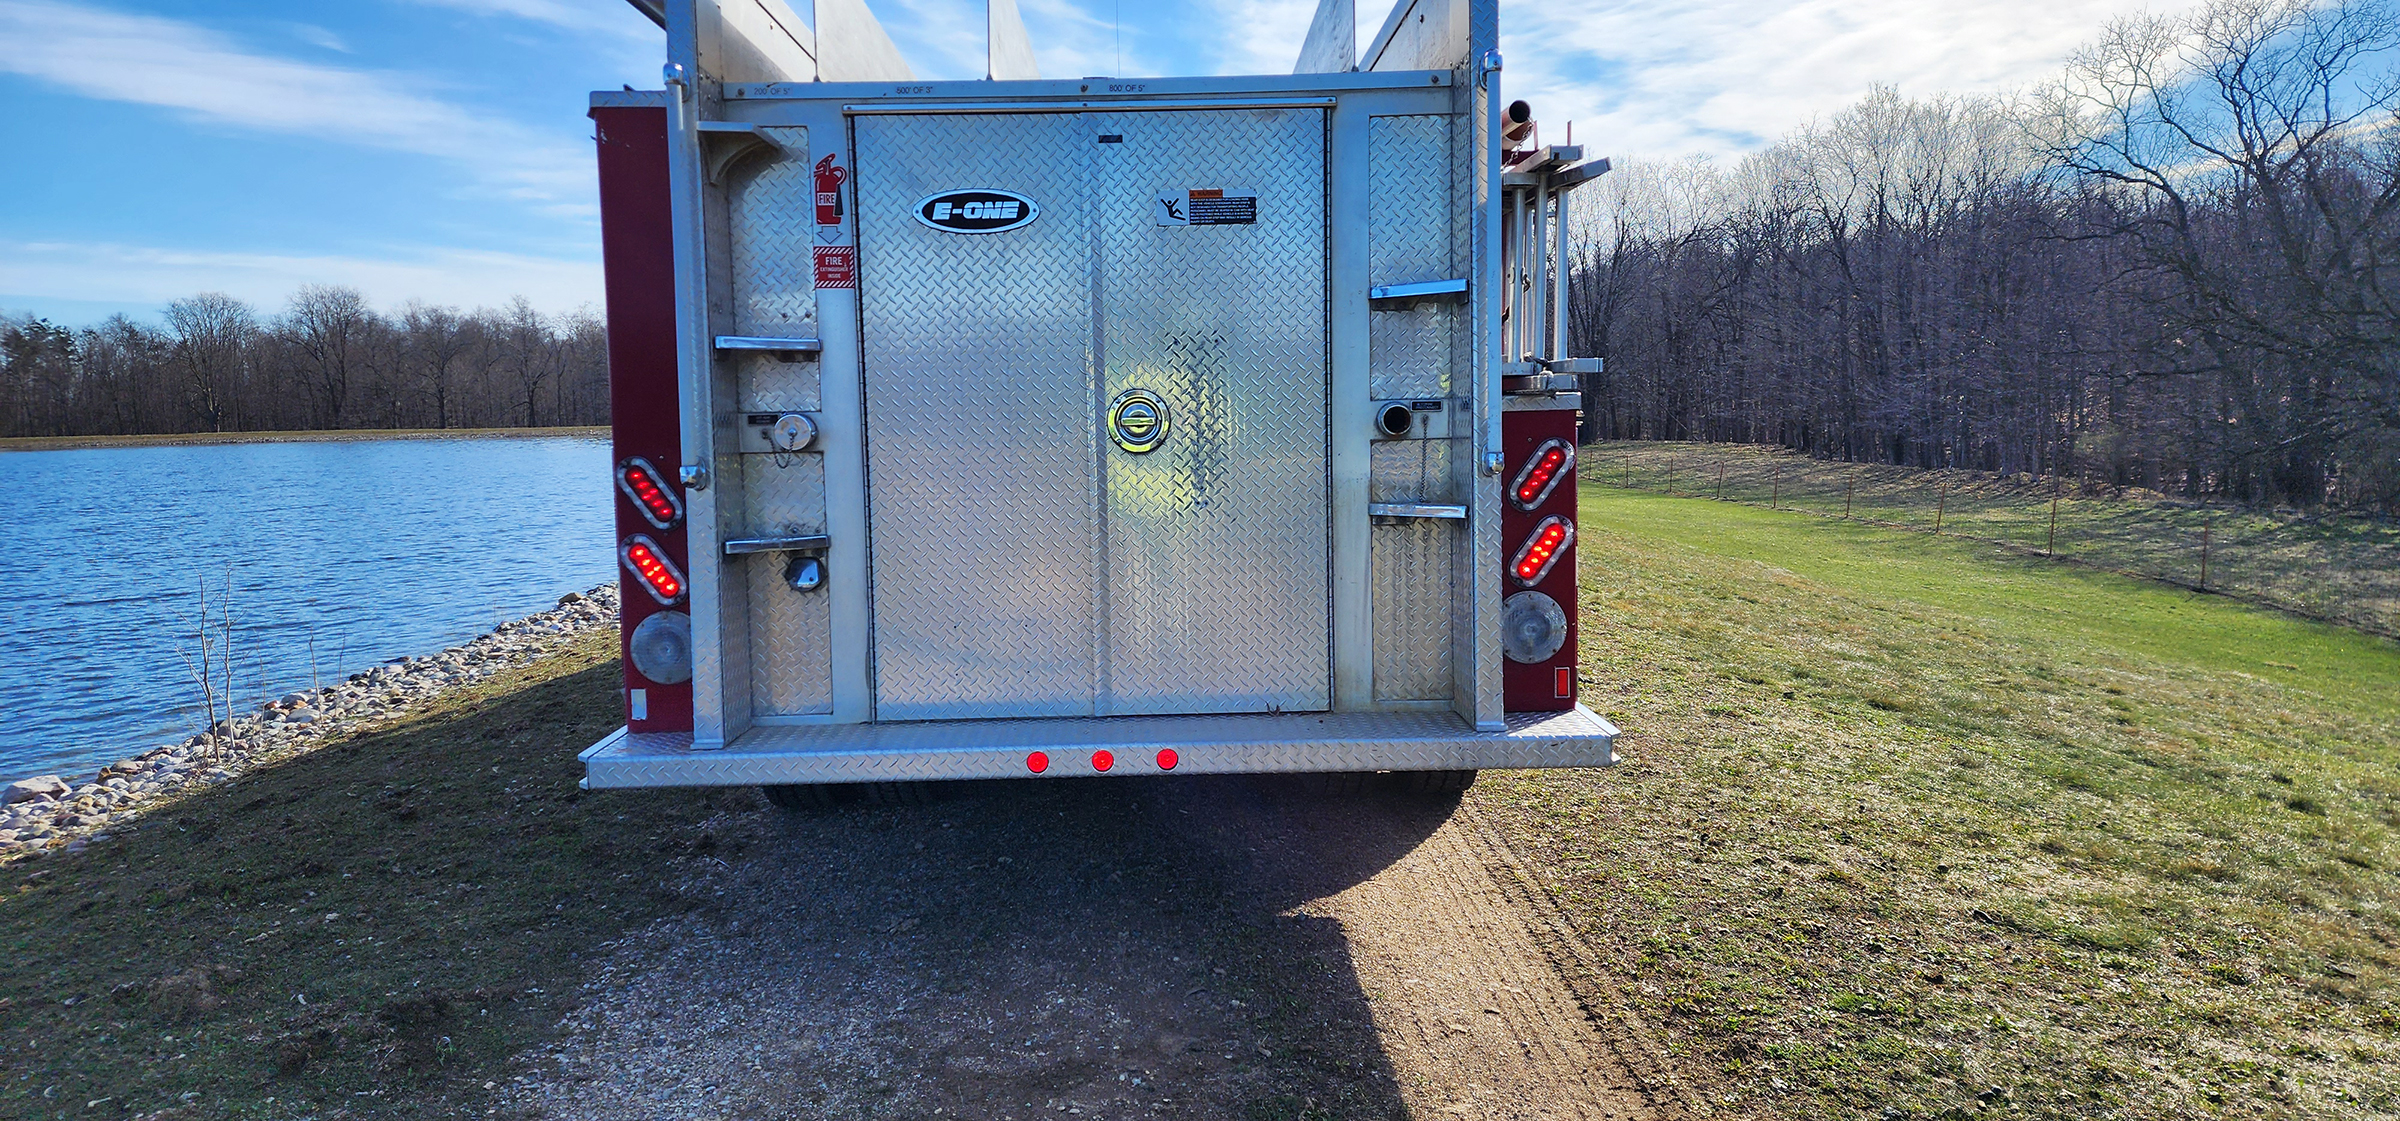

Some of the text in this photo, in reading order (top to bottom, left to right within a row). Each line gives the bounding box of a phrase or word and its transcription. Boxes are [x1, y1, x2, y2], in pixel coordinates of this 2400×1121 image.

[770, 87, 781, 96] OF
[912, 86, 924, 94] OF
[1125, 84, 1136, 92] OF
[818, 193, 835, 205] FIRE
[932, 201, 1020, 220] E-ONE
[825, 256, 843, 266] FIRE
